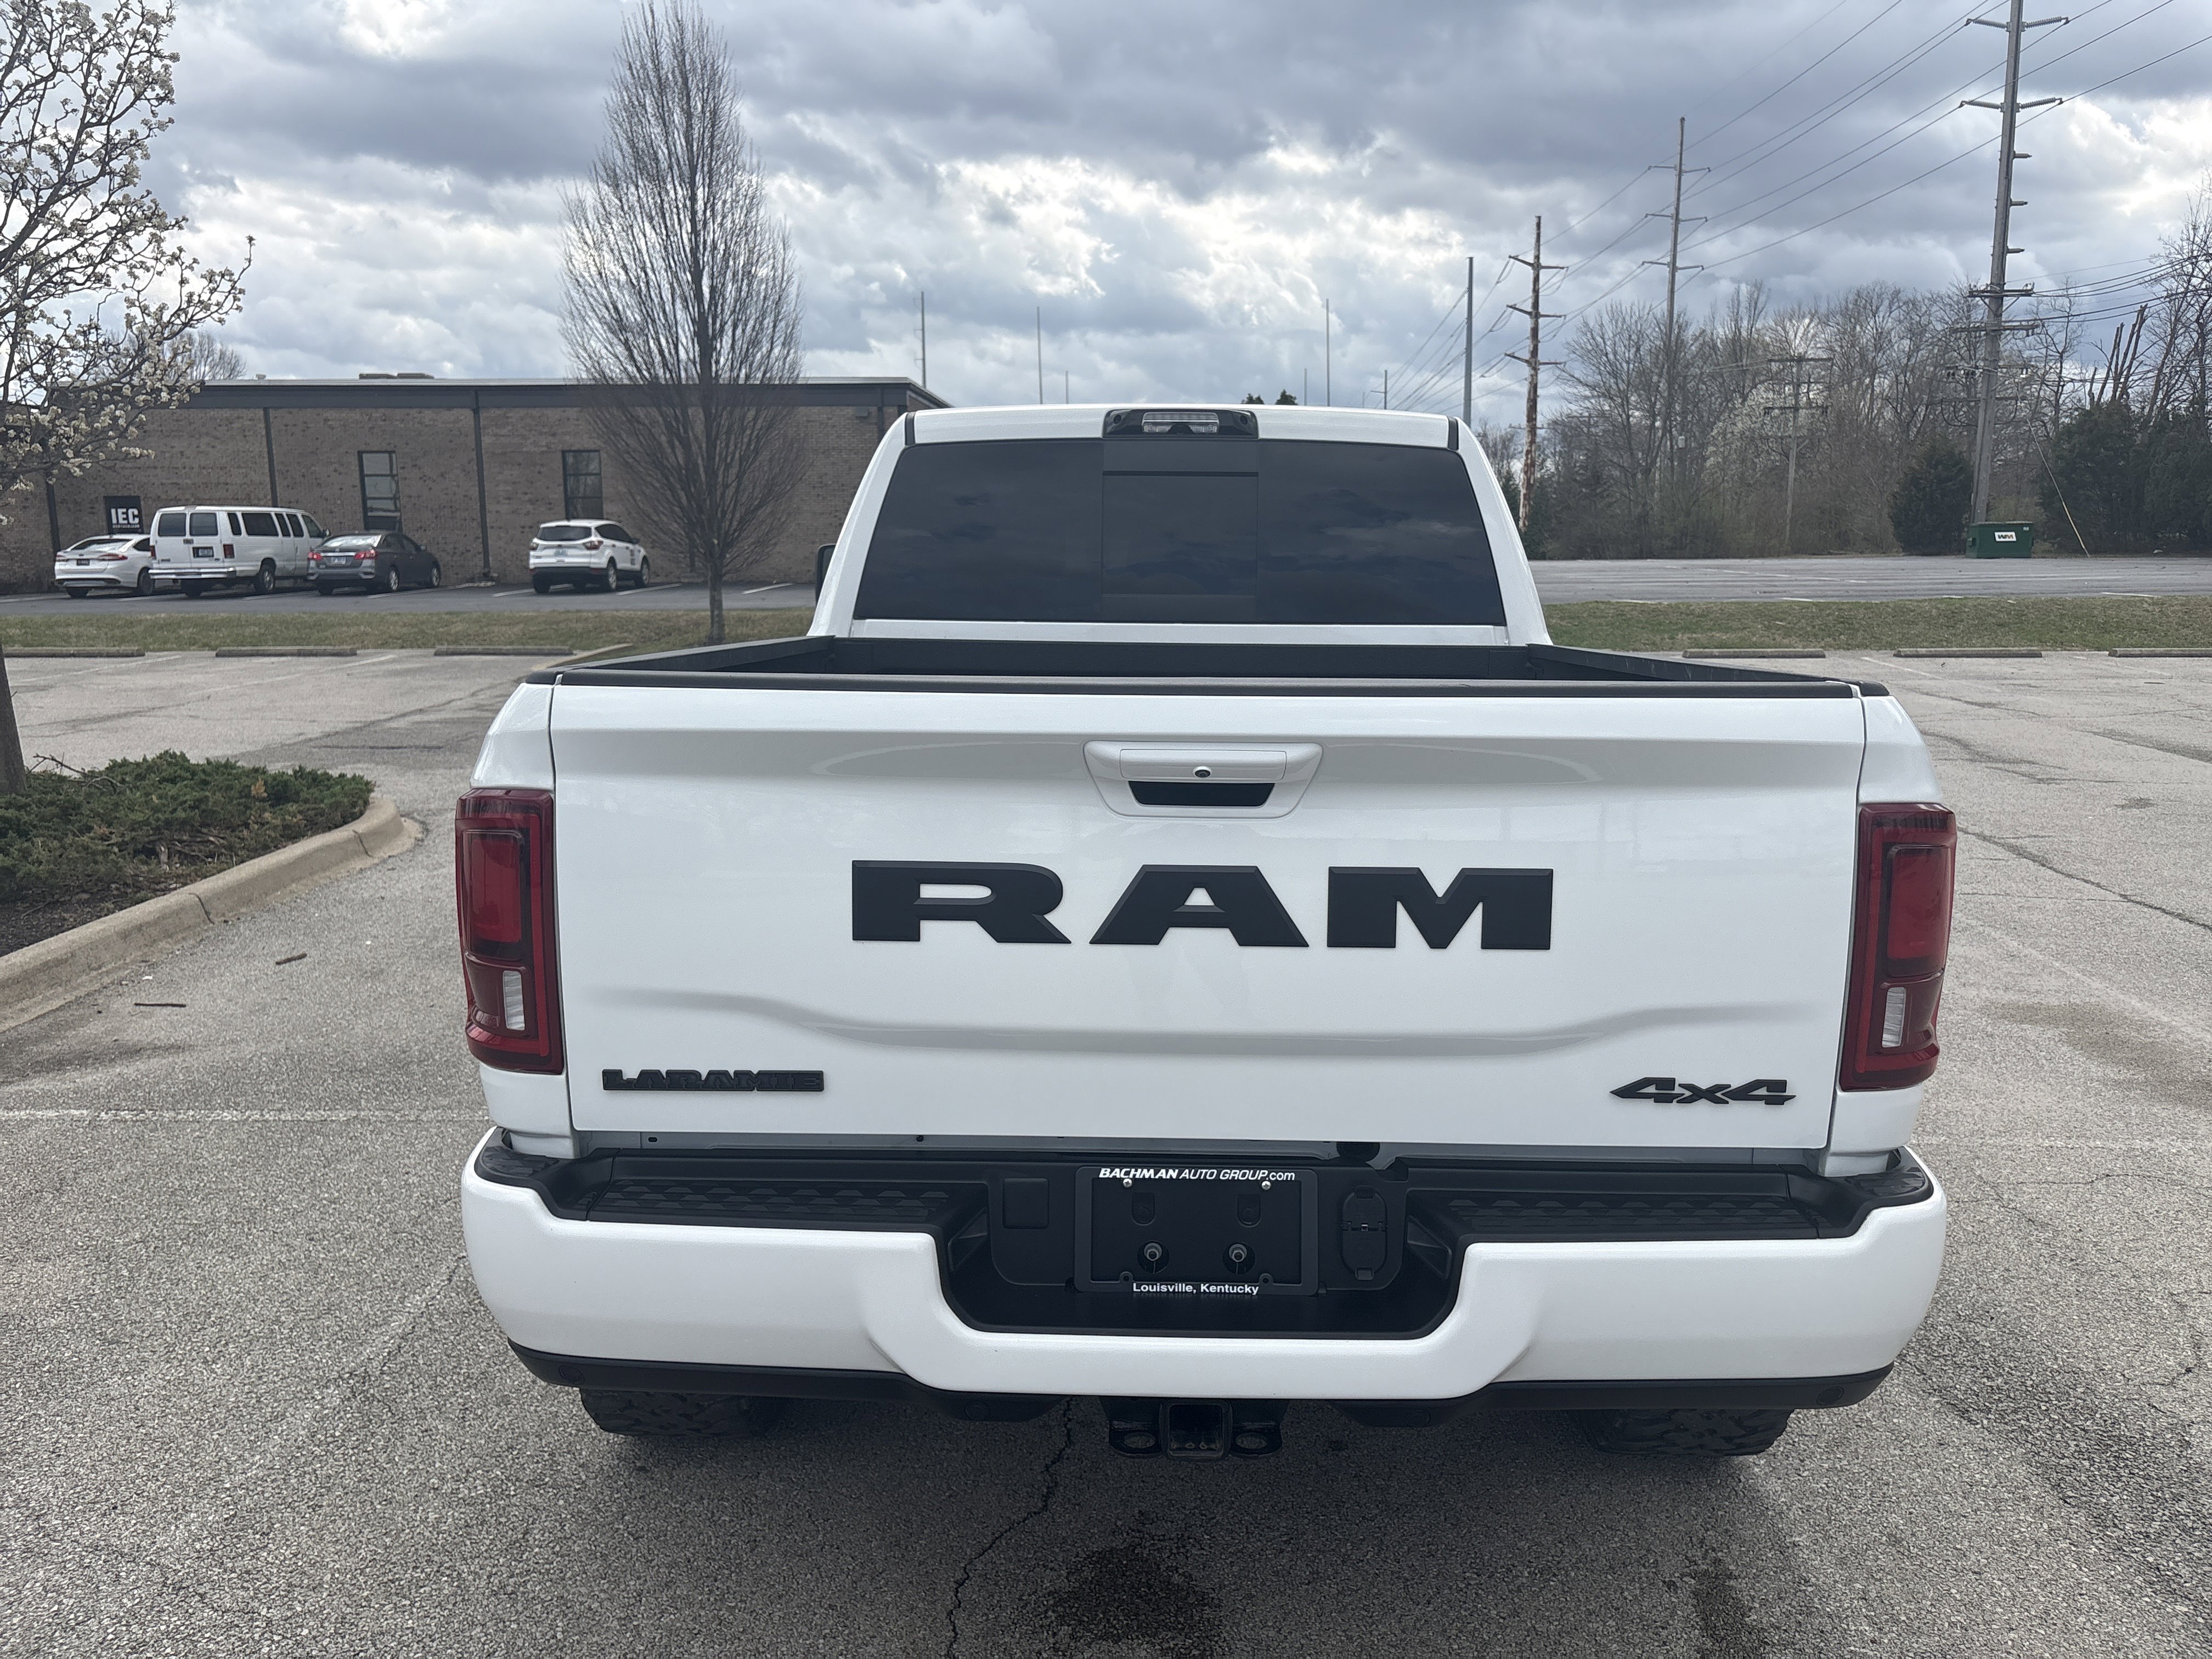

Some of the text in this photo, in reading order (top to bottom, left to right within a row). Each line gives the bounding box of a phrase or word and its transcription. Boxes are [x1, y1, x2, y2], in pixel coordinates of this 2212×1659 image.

[111, 508, 139, 524] IEC
[851, 860, 1554, 950] RAM
[602, 1069, 825, 1092] LARAMIE
[1610, 1077, 1797, 1105] 4x4
[1099, 1167, 1295, 1181] BACHMAN AUTO GROUP.com
[1132, 1283, 1259, 1295] Louisville, Kentucky
